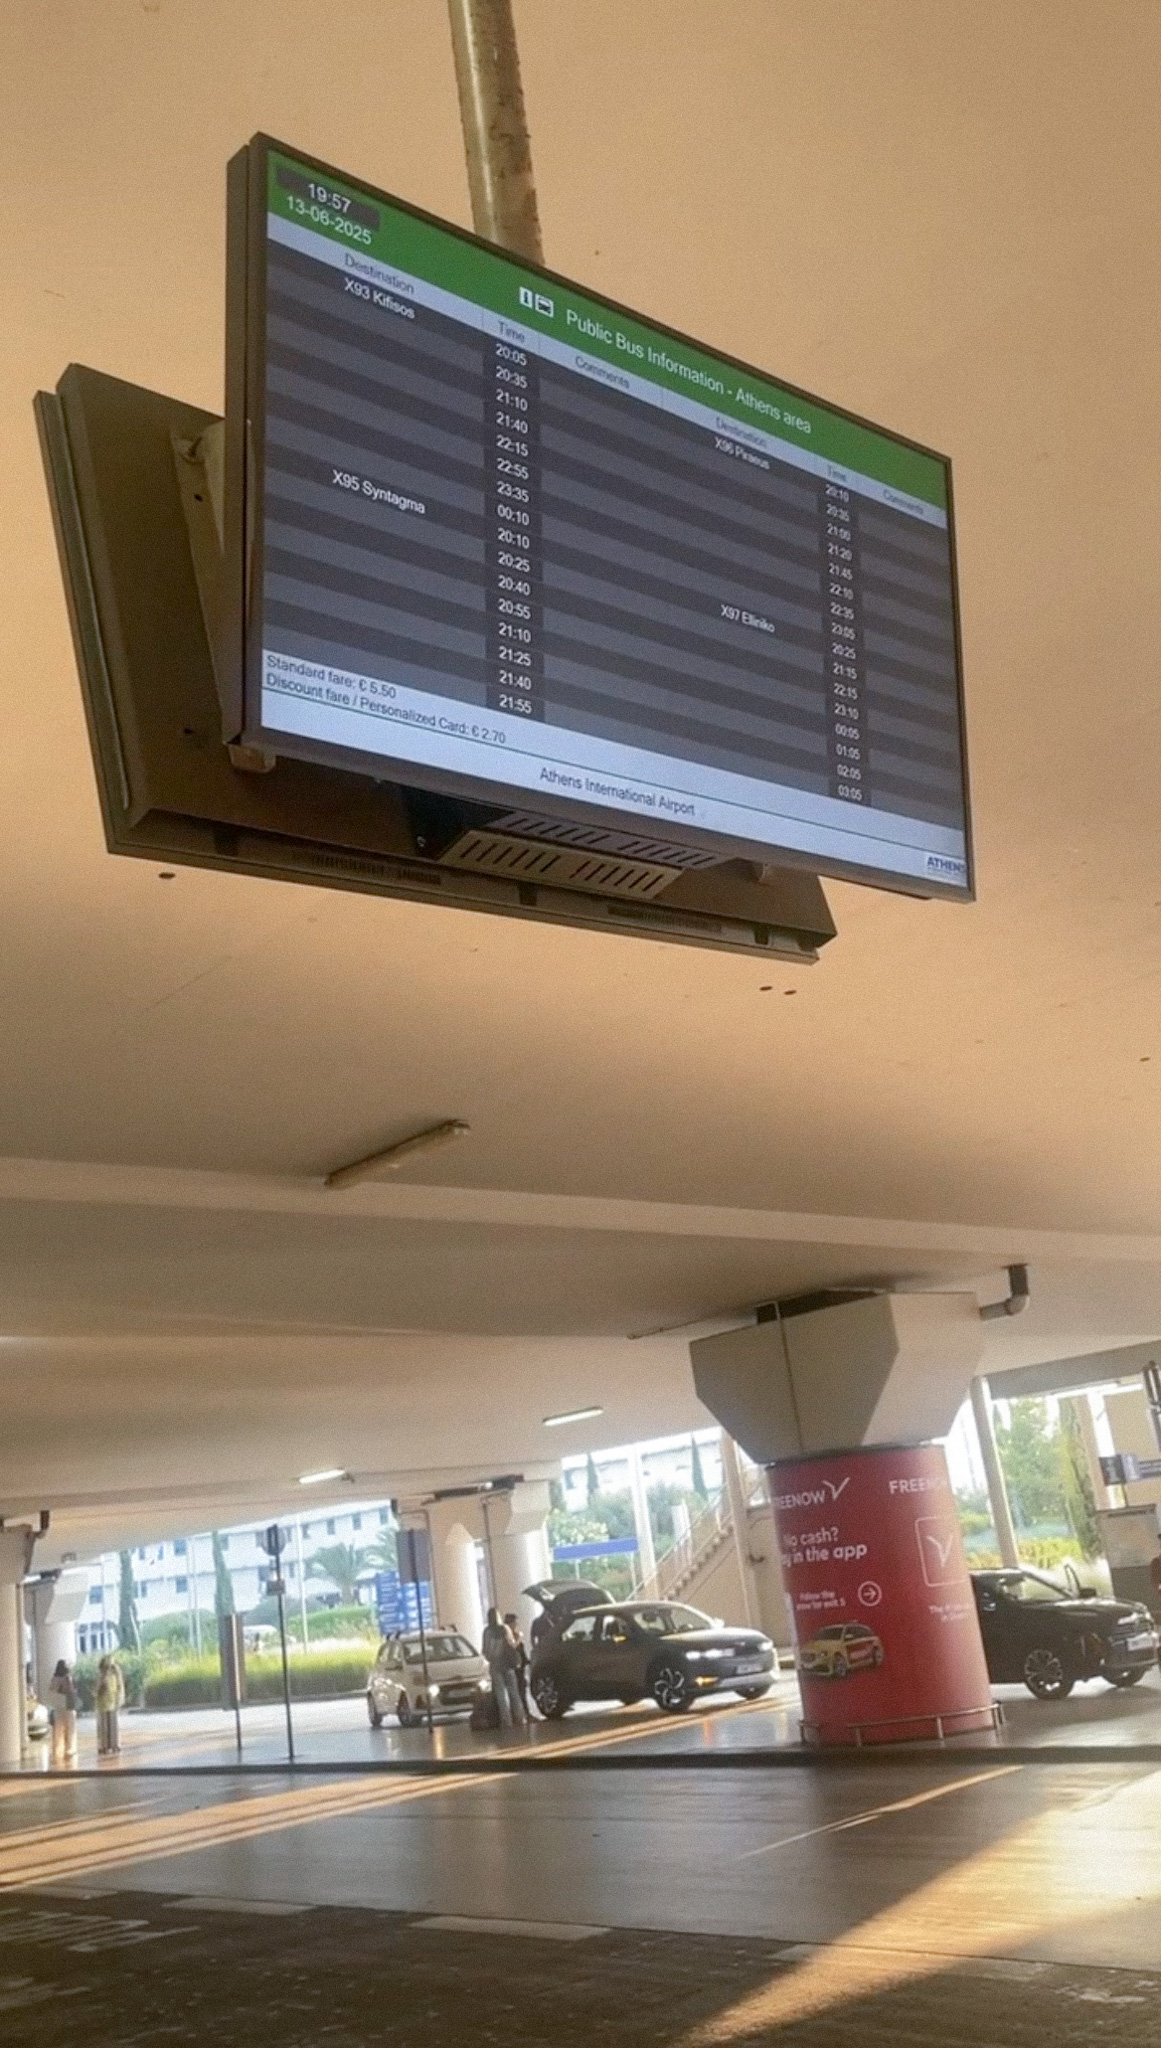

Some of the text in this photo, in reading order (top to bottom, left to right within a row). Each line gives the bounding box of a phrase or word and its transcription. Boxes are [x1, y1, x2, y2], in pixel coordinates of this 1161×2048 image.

[309, 183, 351, 213] 19:57
[345, 253, 414, 293] Destination
[344, 277, 415, 318] X93 Kifisos
[499, 321, 525, 342] Time
[496, 343, 527, 366] 20:05
[496, 365, 528, 388] 20:35
[566, 309, 612, 344] Public
[615, 332, 644, 358] Bus
[648, 347, 724, 394] Information
[735, 387, 781, 421] Athens
[783, 410, 811, 434] area
[575, 356, 630, 389] Comments
[496, 388, 528, 411] 21:10
[496, 411, 528, 434] 21:40
[716, 416, 767, 448] Destination
[496, 434, 529, 457] 22:15
[497, 457, 529, 480] 22:55
[332, 469, 425, 514] X95 Syntagma
[497, 481, 529, 503] 23:35
[497, 504, 530, 526] 00:10
[498, 527, 530, 549] 20:10
[498, 551, 530, 573] 20:25
[498, 575, 530, 596] 20:40
[498, 598, 531, 620] 20:55
[721, 604, 739, 621] X97
[498, 622, 531, 643] 21:10
[499, 646, 531, 667] 21:25
[267, 655, 397, 699] Standard fare: € 5.50
[499, 669, 532, 691] 21:40
[833, 662, 857, 680] 21:15
[833, 682, 858, 700] 22:15
[266, 672, 323, 699] Discount
[326, 688, 350, 705] fare
[360, 697, 436, 727] Personalized
[438, 717, 470, 735] Card:
[471, 725, 480, 738] €
[481, 728, 506, 744] 2.70
[499, 694, 532, 715] 21:55
[836, 743, 861, 760] 01:05
[837, 764, 862, 781] 02:05
[540, 767, 696, 817] Athens International Airport
[838, 784, 863, 801] 03:05
[800, 1526, 839, 1545] cash?
[805, 1546, 829, 1562] the
[832, 1543, 868, 1562] app
